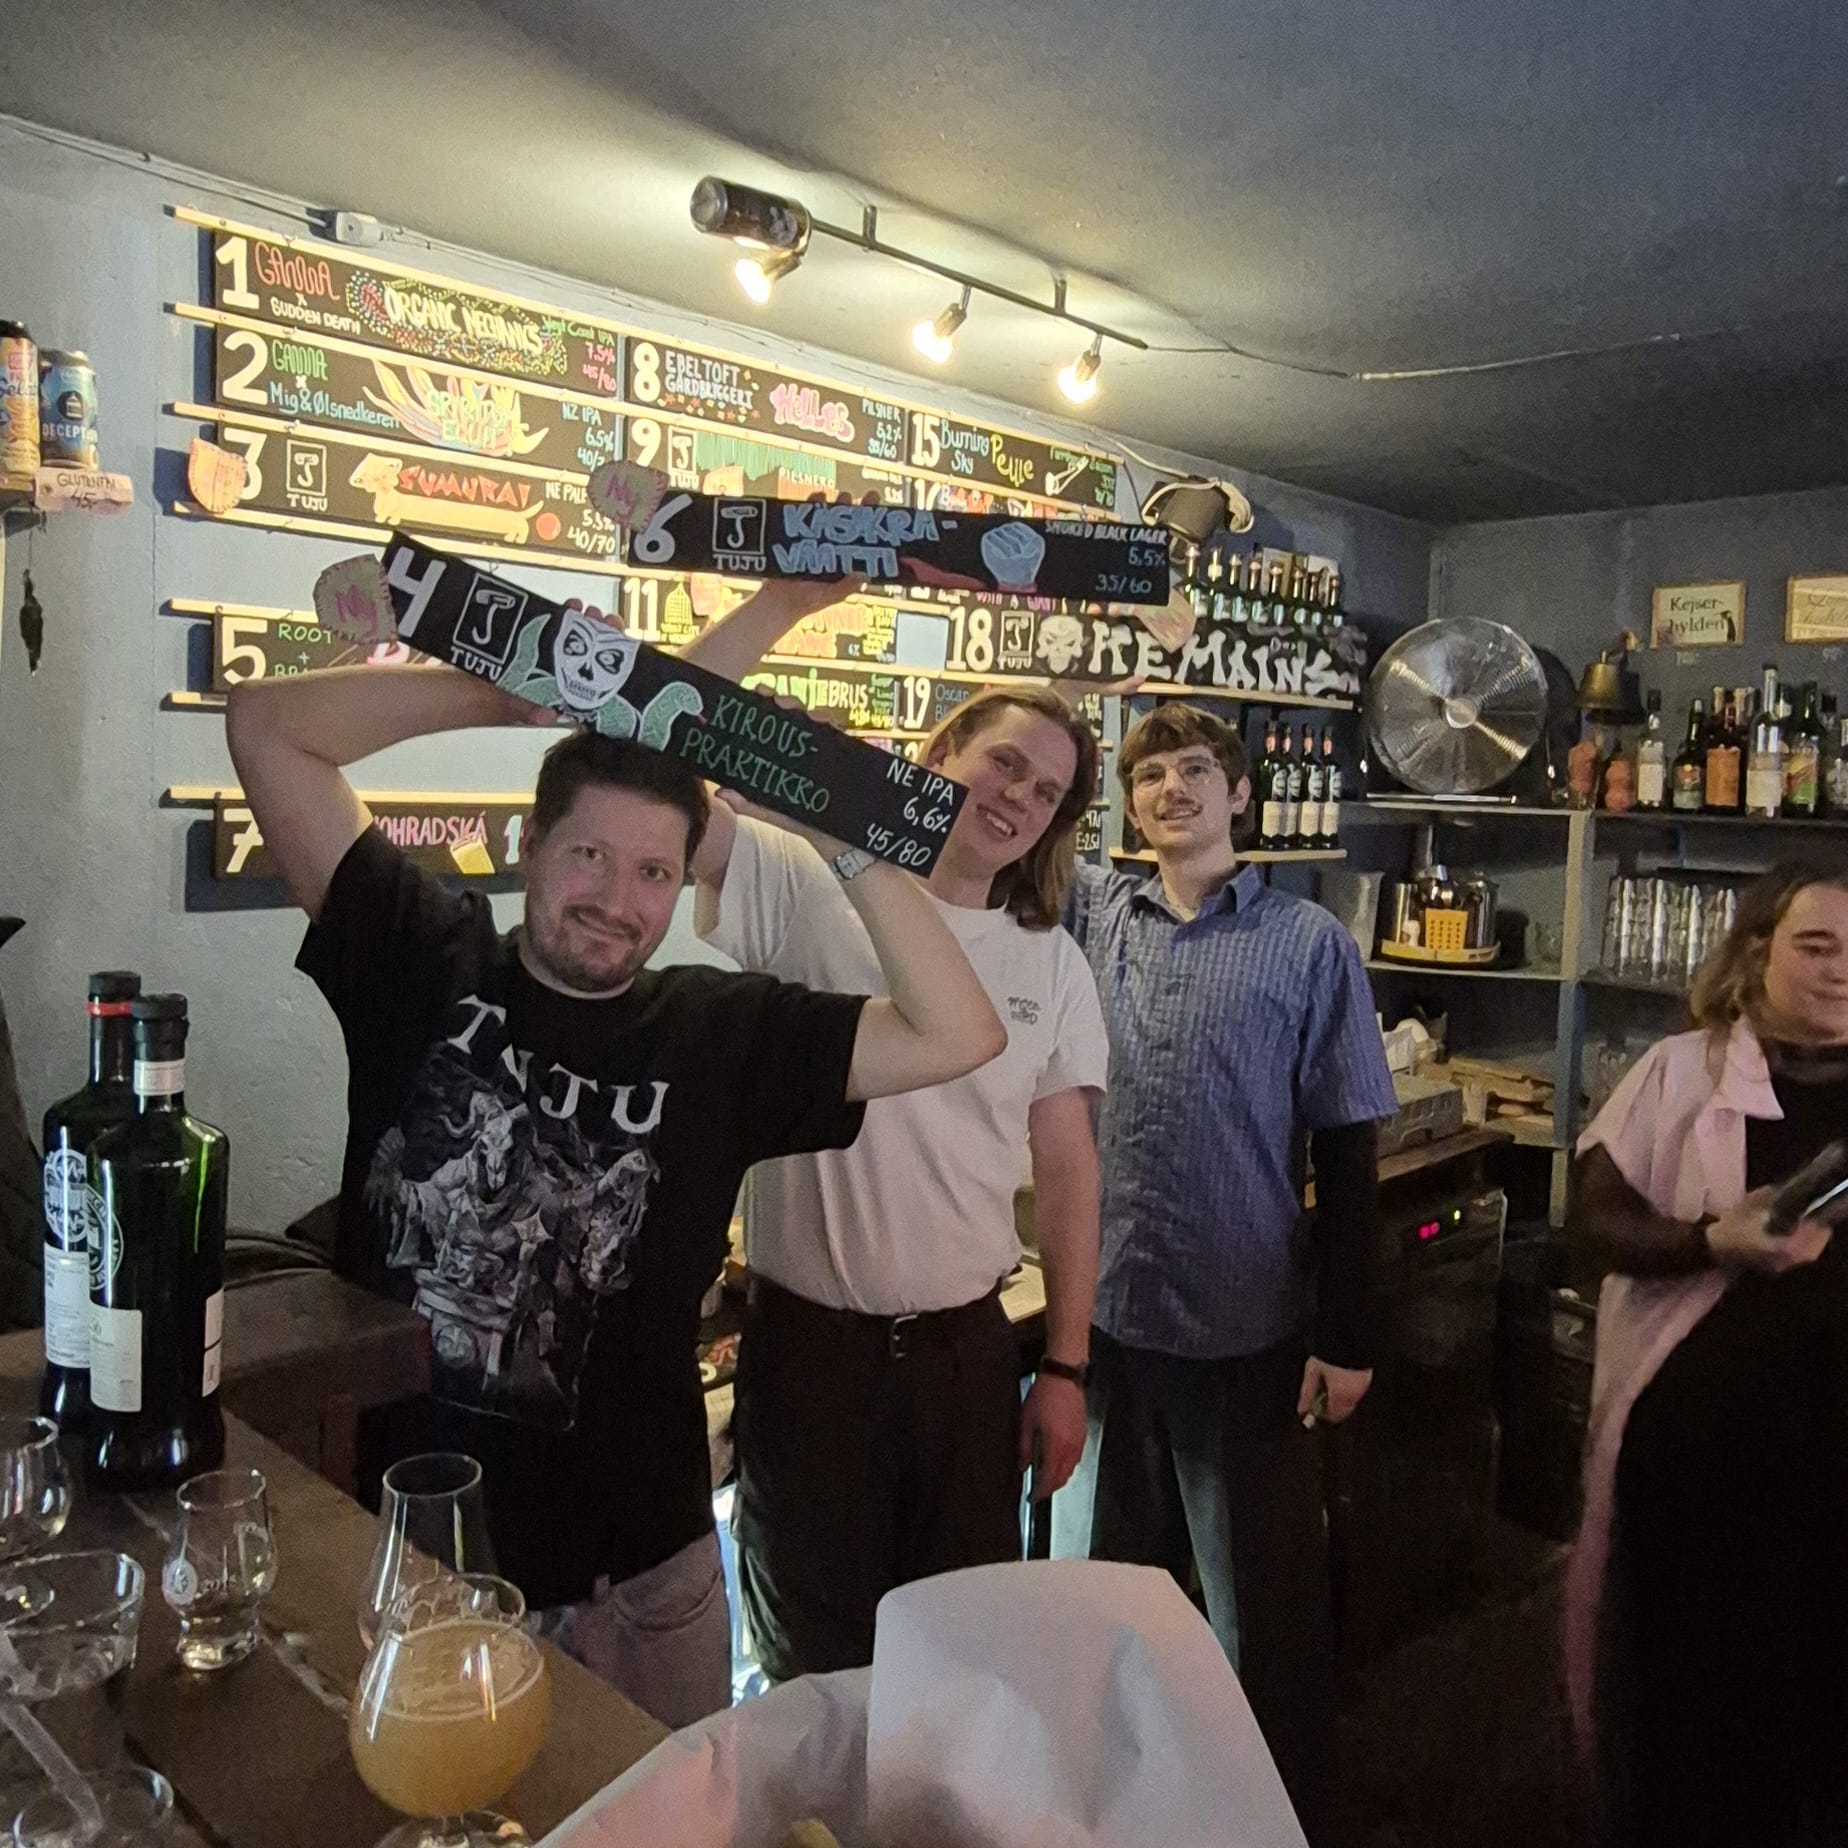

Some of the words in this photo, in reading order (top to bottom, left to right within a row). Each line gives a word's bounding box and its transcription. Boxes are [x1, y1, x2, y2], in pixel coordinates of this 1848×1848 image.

[215, 236, 260, 310] 1
[222, 330, 269, 406] 2
[632, 341, 662, 402] 8
[223, 427, 267, 501] 3
[631, 418, 662, 468] 9
[911, 412, 942, 468] 15
[951, 450, 974, 475] Sky
[286, 493, 328, 513] TUJU
[634, 493, 693, 564] 6
[568, 526, 616, 553] 40/70
[1094, 524, 1129, 543] BLACK
[1129, 528, 1168, 547] LAGER
[713, 554, 768, 573] TUJU
[1095, 573, 1152, 594] 35/60
[388, 546, 447, 639] 4
[221, 616, 268, 685] 5
[450, 644, 503, 682] TUJU
[945, 605, 994, 672] 18
[996, 653, 1032, 671] TUJU
[710, 694, 820, 758] KIROUS-
[904, 676, 931, 730] 19
[679, 727, 831, 814] PRAKTIKKO
[886, 756, 918, 788] NE
[920, 771, 956, 806] IPA
[866, 822, 932, 867] 45/80
